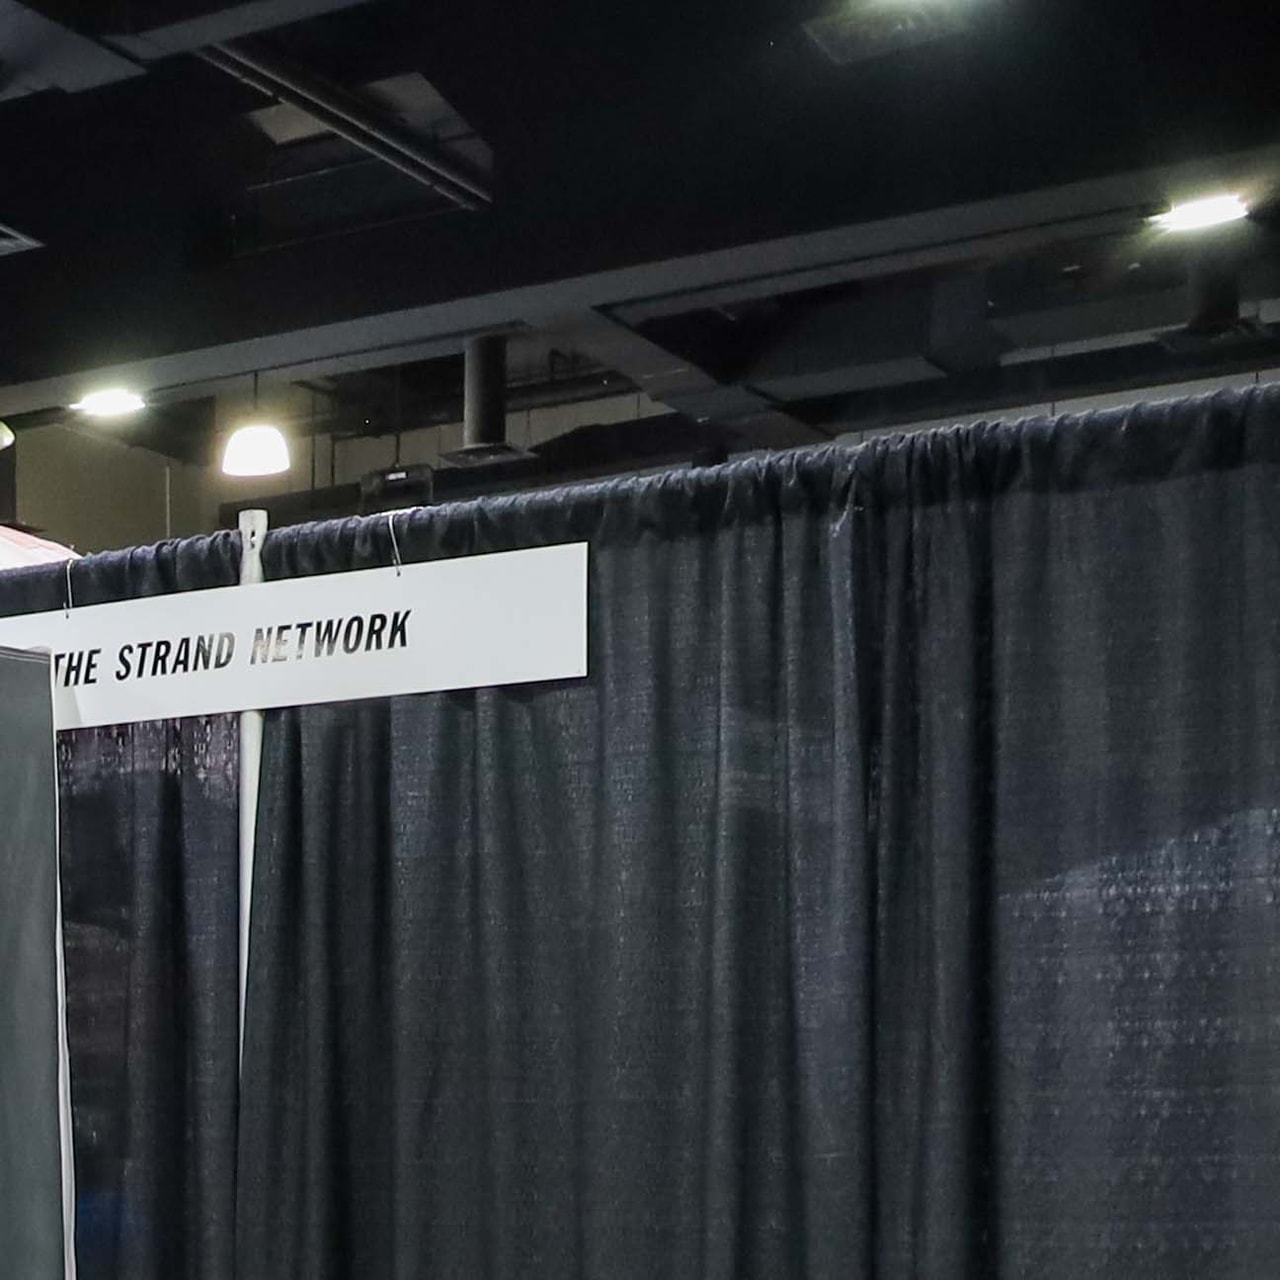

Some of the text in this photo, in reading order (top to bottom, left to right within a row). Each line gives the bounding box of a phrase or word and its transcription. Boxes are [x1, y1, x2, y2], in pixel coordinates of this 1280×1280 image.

[55, 609, 412, 688] THE STRAND NETWORK
